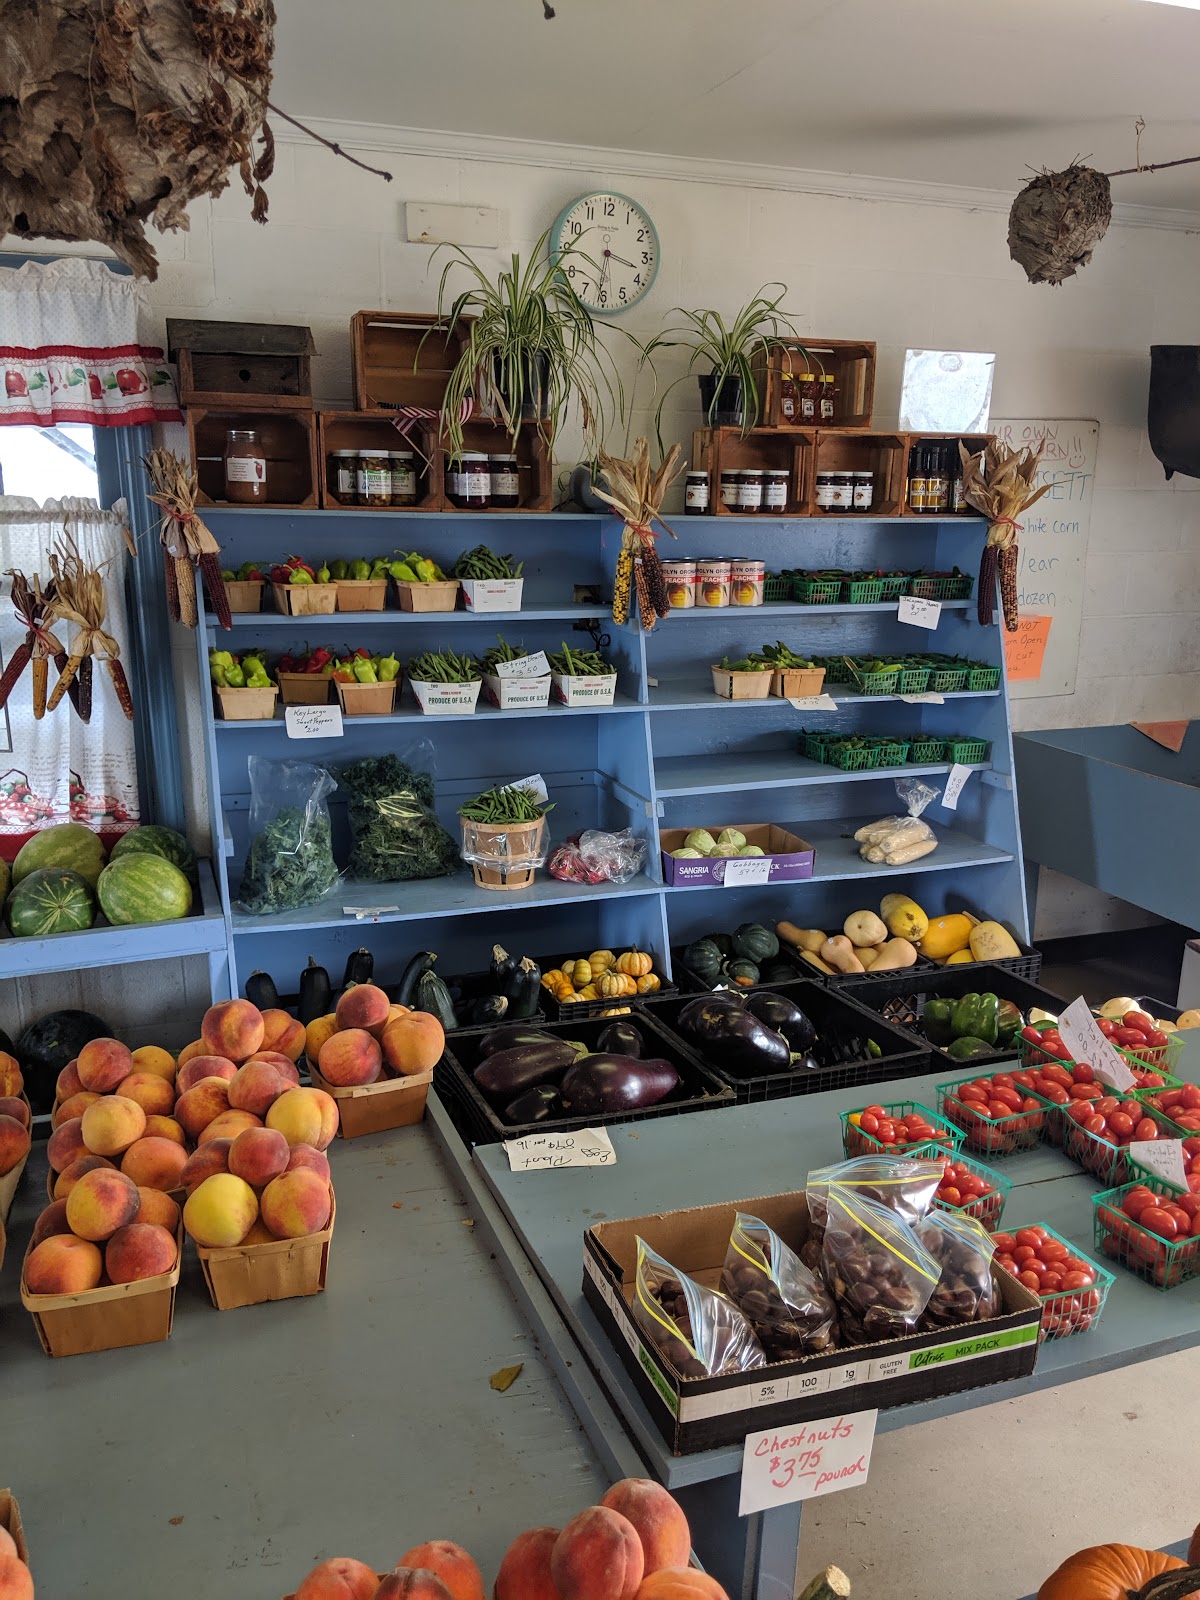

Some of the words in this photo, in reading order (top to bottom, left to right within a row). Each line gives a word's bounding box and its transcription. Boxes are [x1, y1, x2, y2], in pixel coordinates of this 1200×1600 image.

[587, 207, 594, 220] 11
[604, 202, 615, 216] 12
[626, 211, 630, 225] 1
[570, 221, 582, 235] 10
[636, 229, 644, 242] 2
[641, 252, 649, 264] 3
[568, 265, 575, 278] 8
[633, 273, 640, 285] 4
[582, 282, 589, 295] 7
[619, 287, 626, 299] 5
[600, 290, 607, 303] 6
[1022, 425, 1059, 440] OWN
[1018, 587, 1056, 607] dozen
[1019, 621, 1041, 630] NOT
[1021, 634, 1042, 648] Open
[1016, 650, 1034, 660] cut
[503, 660, 526, 671] String
[307, 708, 327, 717] Largo
[679, 866, 709, 875] SANGRIA
[581, 1148, 611, 1162] Egg
[880, 1360, 902, 1369] GLUTEN
[914, 1350, 945, 1368] Citrus
[955, 1345, 972, 1356] MIX
[975, 1339, 1000, 1352] PACK
[845, 1370, 855, 1378] 1g
[883, 1368, 898, 1376] FREE
[801, 1377, 817, 1387] 100
[760, 1386, 775, 1396] 5%
[754, 1417, 854, 1456] Chestnuts
[814, 1455, 865, 1491] pound
